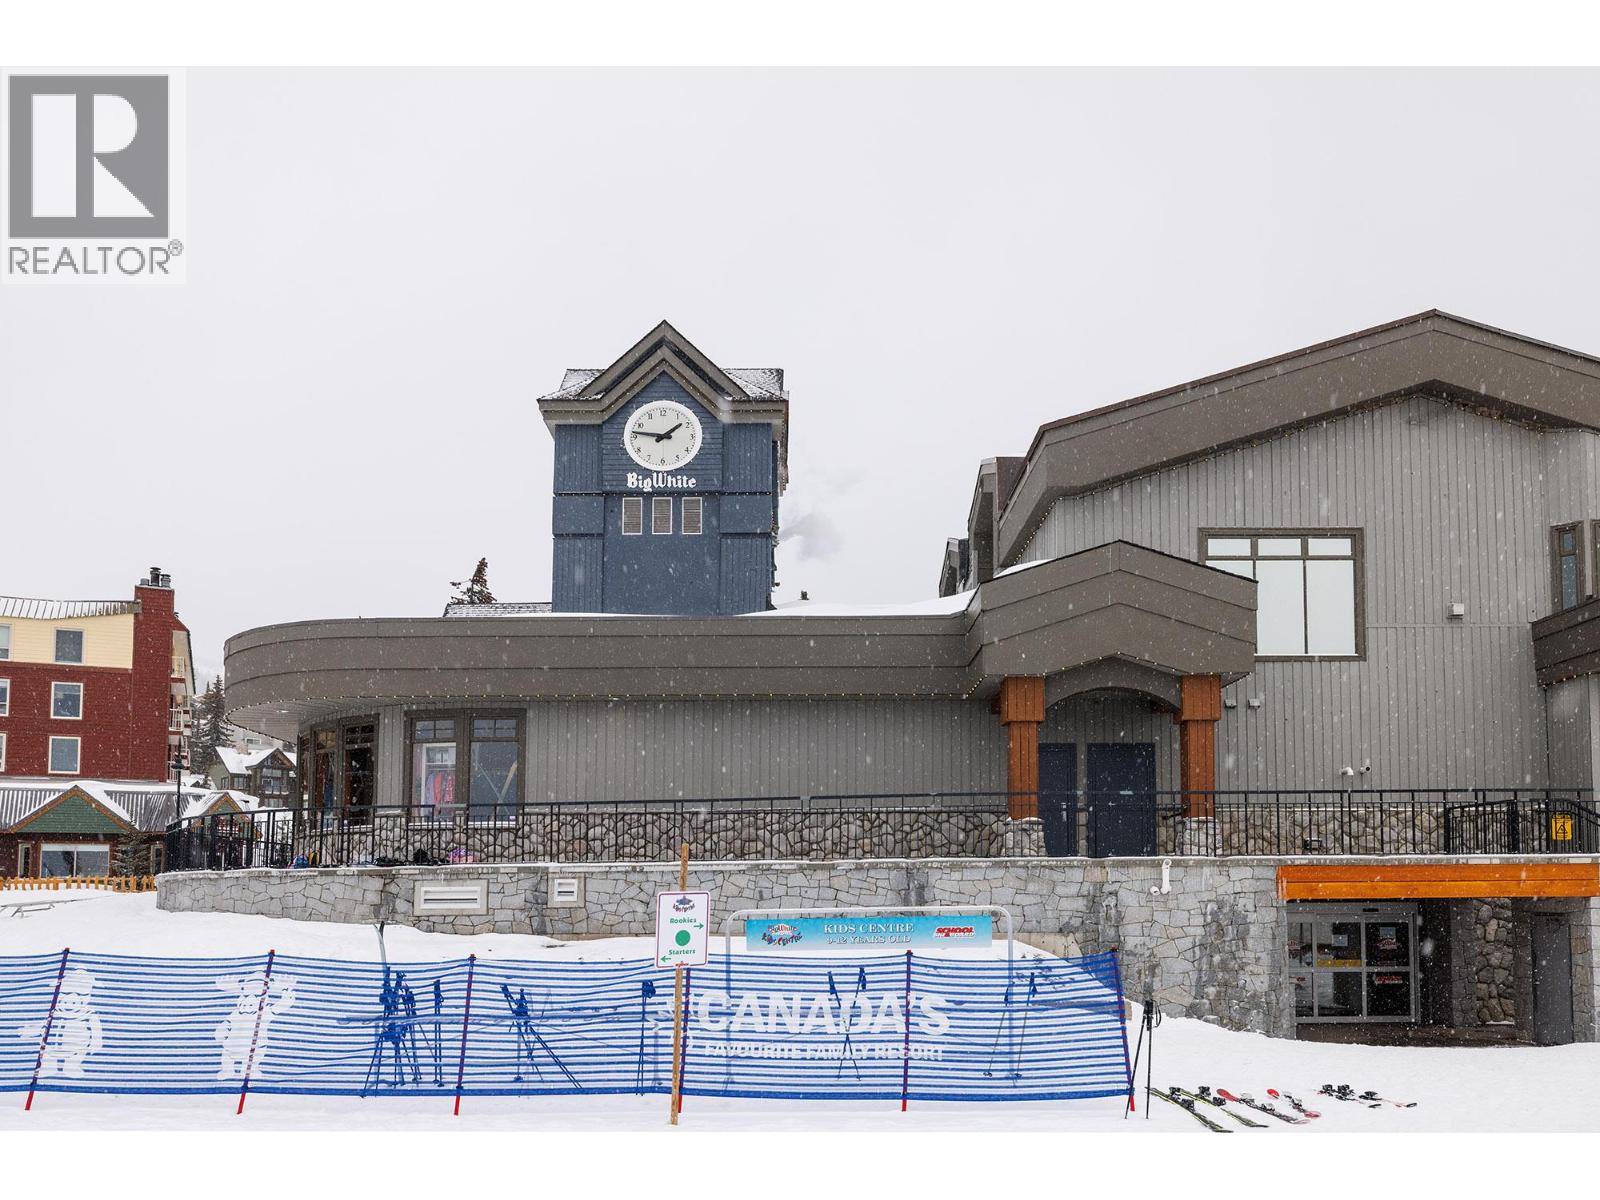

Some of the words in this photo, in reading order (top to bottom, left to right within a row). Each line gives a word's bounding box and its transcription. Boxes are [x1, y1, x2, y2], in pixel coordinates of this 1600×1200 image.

[660, 457, 666, 465] 6
[824, 924, 856, 934] KIDS
[859, 923, 914, 934] CENTRE
[936, 927, 974, 935] SCHOOL
[850, 936, 885, 944] YEARS
[887, 935, 911, 944] OLD
[697, 992, 950, 1035] CANADA'S
